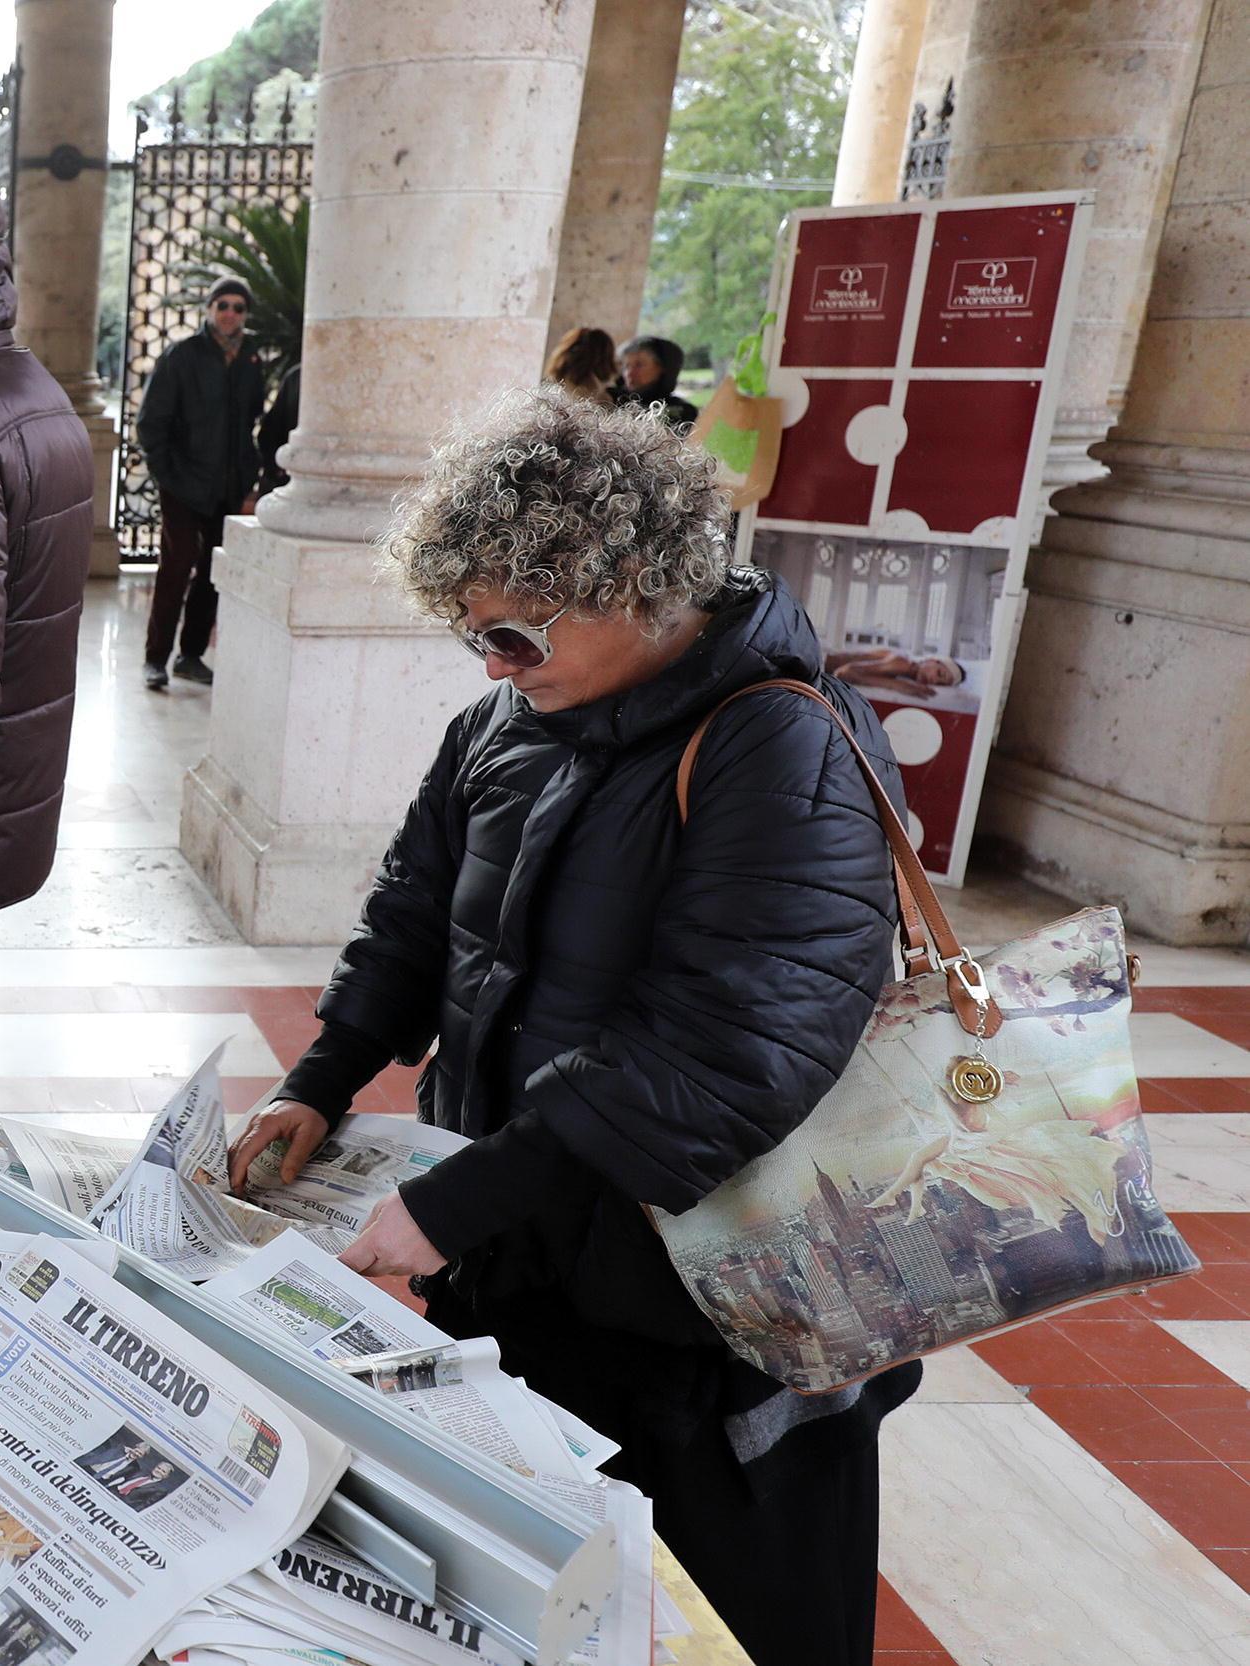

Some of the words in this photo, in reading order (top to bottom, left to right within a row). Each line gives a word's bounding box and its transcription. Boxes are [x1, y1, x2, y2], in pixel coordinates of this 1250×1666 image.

[136, 1183, 146, 1217] Insieme
[146, 1192, 159, 1231] Gentiloni
[326, 1208, 335, 1220] la
[334, 1211, 358, 1230] Trova
[251, 1298, 308, 1335] CODACONS
[2, 1337, 28, 1362] VOTO
[62, 1297, 98, 1335] IL
[89, 1314, 209, 1417] TIRRENO
[14, 1376, 38, 1398] lancia
[38, 1395, 77, 1426] Gentiloni
[20, 1360, 45, 1382] Prodi
[43, 1378, 60, 1395] vota
[58, 1390, 92, 1420] Insieme
[39, 1359, 52, 1370] MOSSA
[58, 1374, 90, 1400] CENTROSINISTRA
[87, 1351, 107, 1368] PISTOIA
[110, 1368, 128, 1384] PRATO
[130, 1384, 166, 1413] MONTECATINI
[16, 1395, 30, 1410] te
[25, 1404, 46, 1422] Italia
[42, 1418, 60, 1433] più
[58, 1429, 86, 1450] forte»
[6, 1465, 33, 1489] money
[31, 1486, 64, 1512] transfer
[61, 1510, 98, 1544] nell'area
[96, 1541, 118, 1561] della
[116, 1556, 132, 1570] Ztl
[10, 1504, 27, 1520] anche
[31, 1522, 50, 1540] inglese
[27, 1452, 57, 1485] di
[50, 1467, 166, 1569] delinquenza»
[27, 1560, 38, 1573] e
[36, 1568, 74, 1603] spaccate
[42, 1548, 74, 1580] Raffica
[70, 1573, 86, 1590] di
[82, 1585, 108, 1608] furti
[14, 1570, 31, 1589] in
[27, 1582, 60, 1612] negozi
[54, 1606, 67, 1622] e
[64, 1616, 92, 1642] uffici
[445, 1613, 482, 1652] IL
